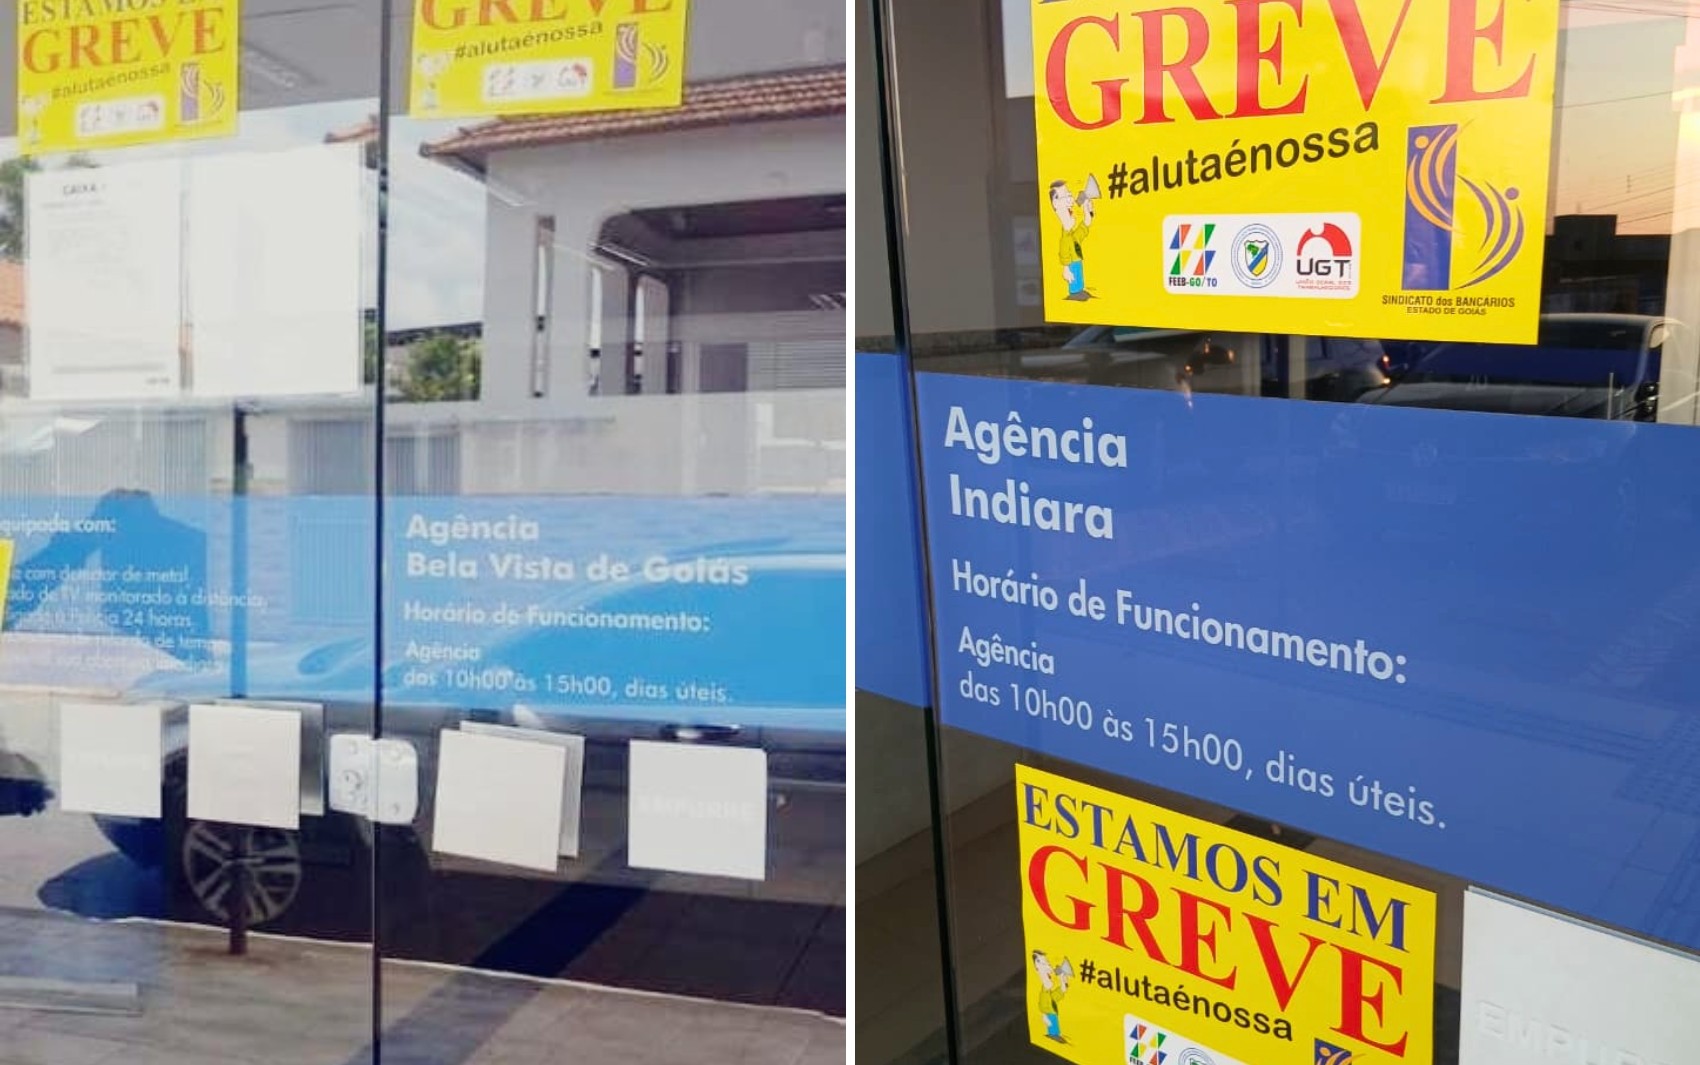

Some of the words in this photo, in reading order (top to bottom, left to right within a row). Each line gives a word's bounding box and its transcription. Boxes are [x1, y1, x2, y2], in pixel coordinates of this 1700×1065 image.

[22, 7, 226, 74] GREVE
[1045, 0, 1536, 130] GREVE
[1107, 121, 1380, 199] #alutaénossa
[1296, 257, 1351, 279] UGT
[1382, 294, 1434, 306] SINDICATO
[1436, 296, 1453, 307] dos
[1407, 306, 1442, 315] ESTADO
[1444, 307, 1456, 315] DE
[944, 405, 1128, 468] Agência
[406, 513, 540, 547] Agência
[949, 473, 1114, 540] Indiara
[407, 551, 478, 579] Bela
[489, 553, 575, 582] Vista
[586, 554, 630, 583] de
[643, 553, 749, 585] Goiás
[123, 608, 144, 628] 24
[404, 600, 486, 625] Horário
[492, 602, 522, 626] de
[527, 603, 712, 634] Funcionamento:
[952, 558, 1059, 612] Horário
[1067, 578, 1106, 621] de
[1116, 588, 1408, 685] Funcionamento:
[404, 640, 482, 664] Agência
[958, 625, 1055, 676] Agência
[403, 667, 438, 687] das
[546, 673, 617, 700] 15h00,
[625, 677, 668, 700] dias
[959, 670, 1000, 707] das
[1010, 682, 1092, 731] 10h00
[1102, 708, 1133, 743] às
[1144, 716, 1253, 781] 15h00,
[1265, 751, 1335, 798] dias
[1348, 774, 1447, 829] úteis.
[1022, 782, 1284, 907] ESTAMOS
[1302, 868, 1411, 954] EM
[1027, 844, 1411, 1059] GREVE
[1078, 957, 1294, 1042] #alutaénossa
